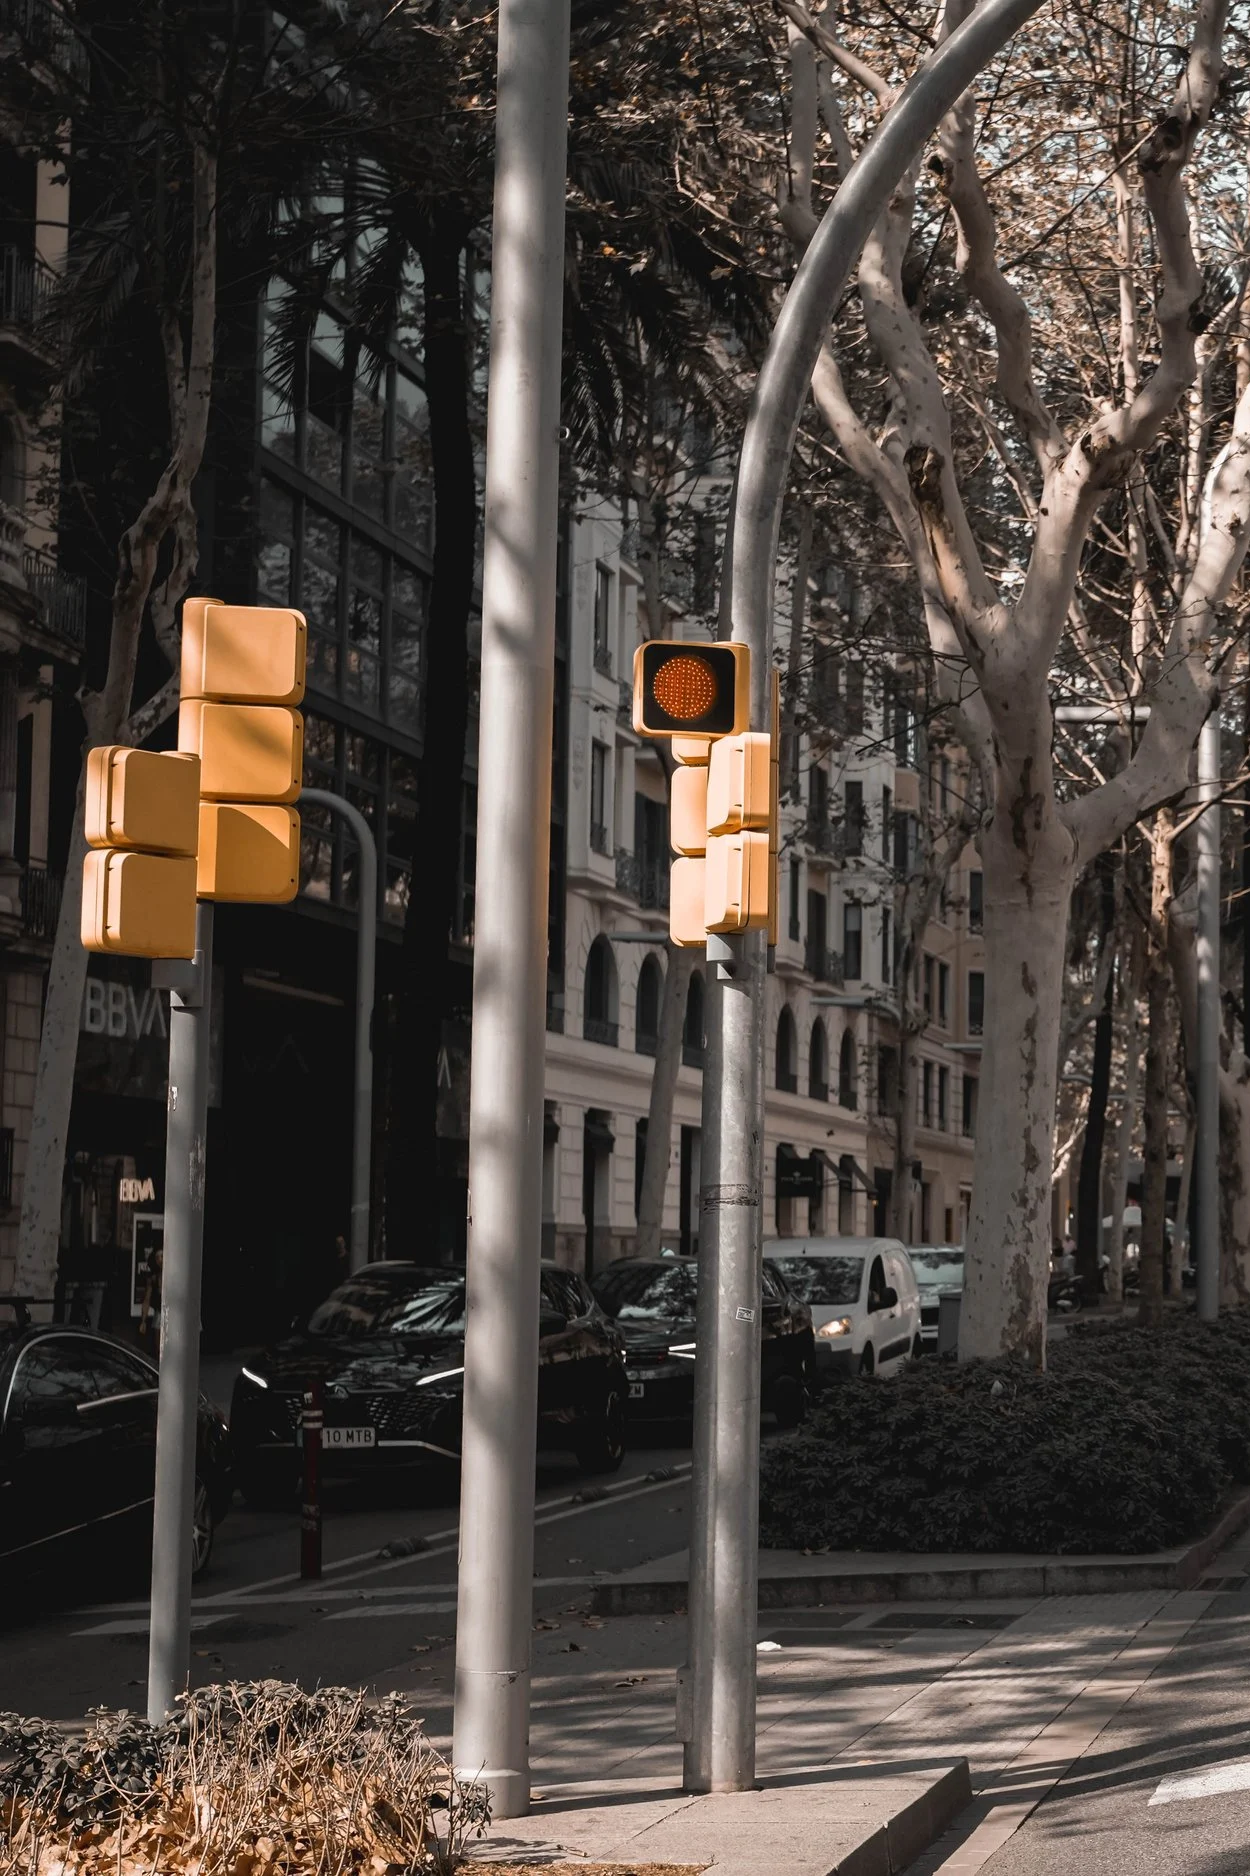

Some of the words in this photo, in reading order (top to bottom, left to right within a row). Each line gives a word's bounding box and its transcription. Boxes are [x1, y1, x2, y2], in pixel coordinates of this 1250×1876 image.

[86, 976, 167, 1040] BBVA
[120, 1177, 156, 1203] BBVA
[346, 1429, 372, 1443] MTB
